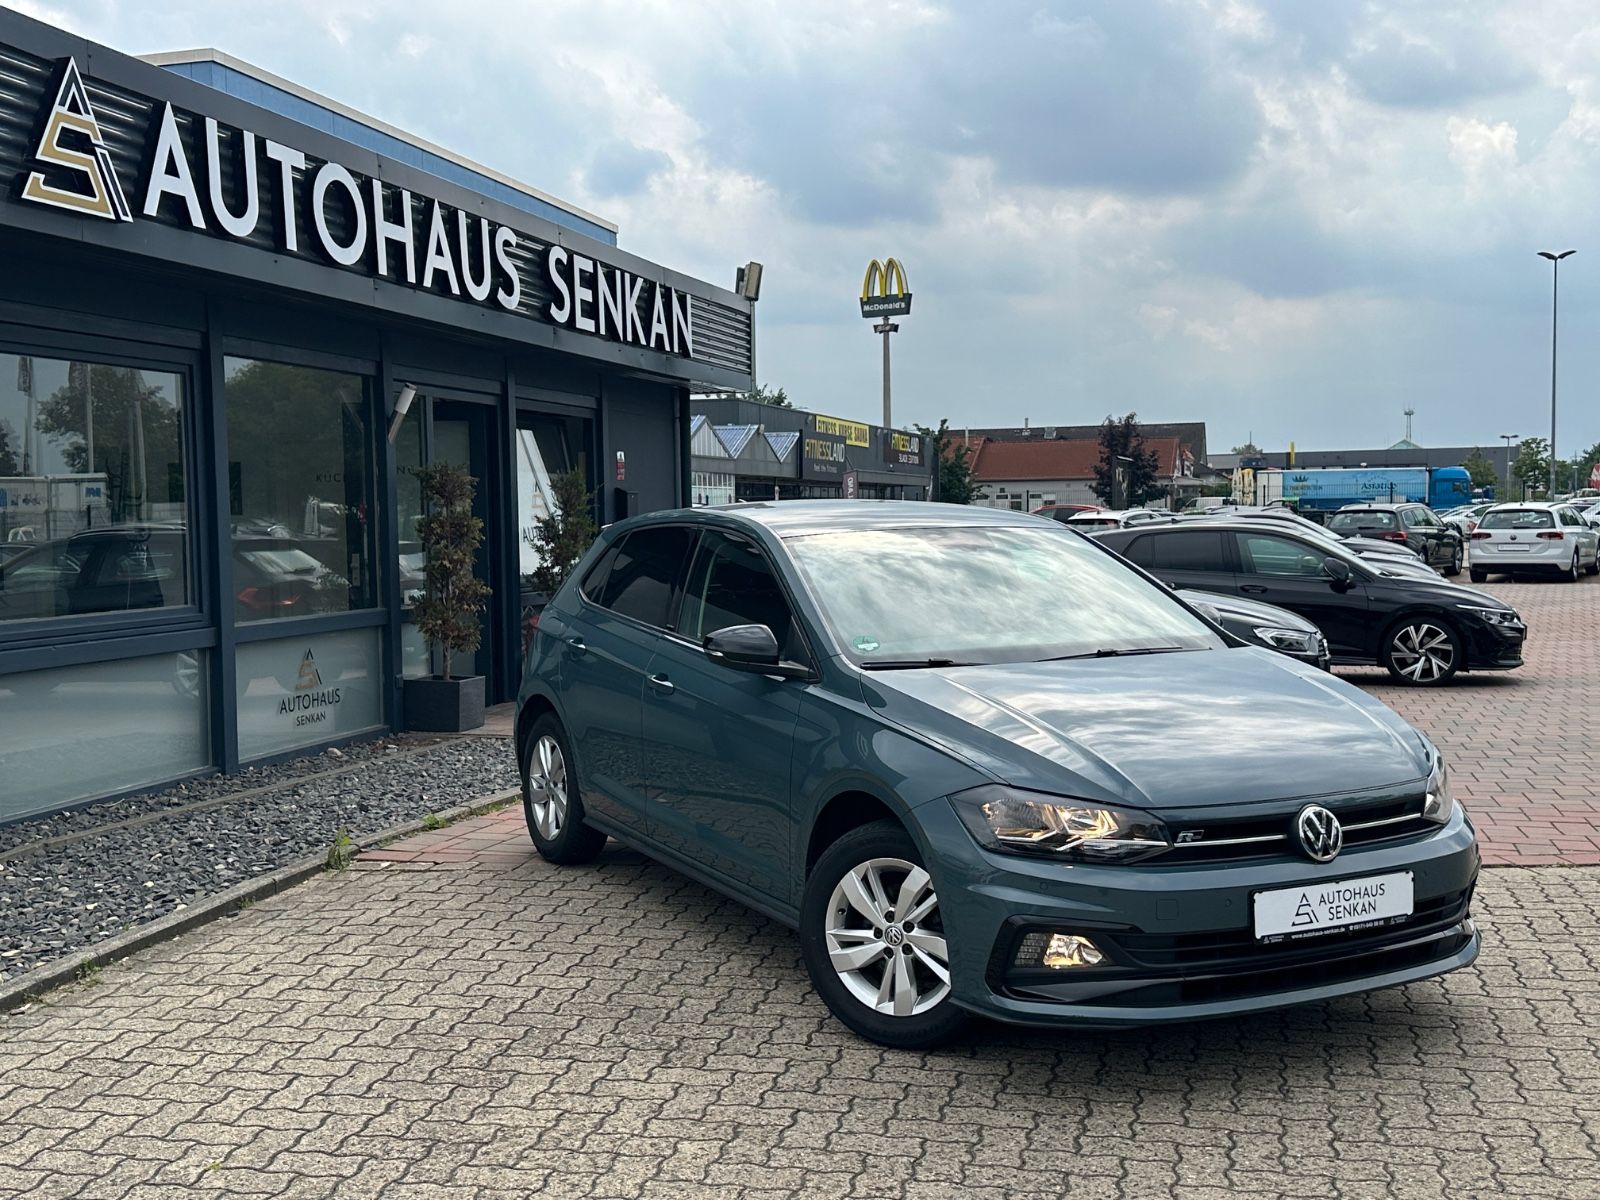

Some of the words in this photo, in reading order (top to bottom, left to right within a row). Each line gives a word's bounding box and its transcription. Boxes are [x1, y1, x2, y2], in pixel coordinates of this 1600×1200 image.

[143, 100, 521, 311] AUTOHAUS
[548, 245, 693, 358] SENKAN
[863, 302, 906, 312] McDonald's
[804, 438, 845, 463] FITNESSLAND
[279, 688, 341, 714] AUTOHAUS
[296, 711, 326, 726] SENKAN
[1318, 883, 1386, 907] AUTOHAUS
[1328, 900, 1377, 921] SENKAN
